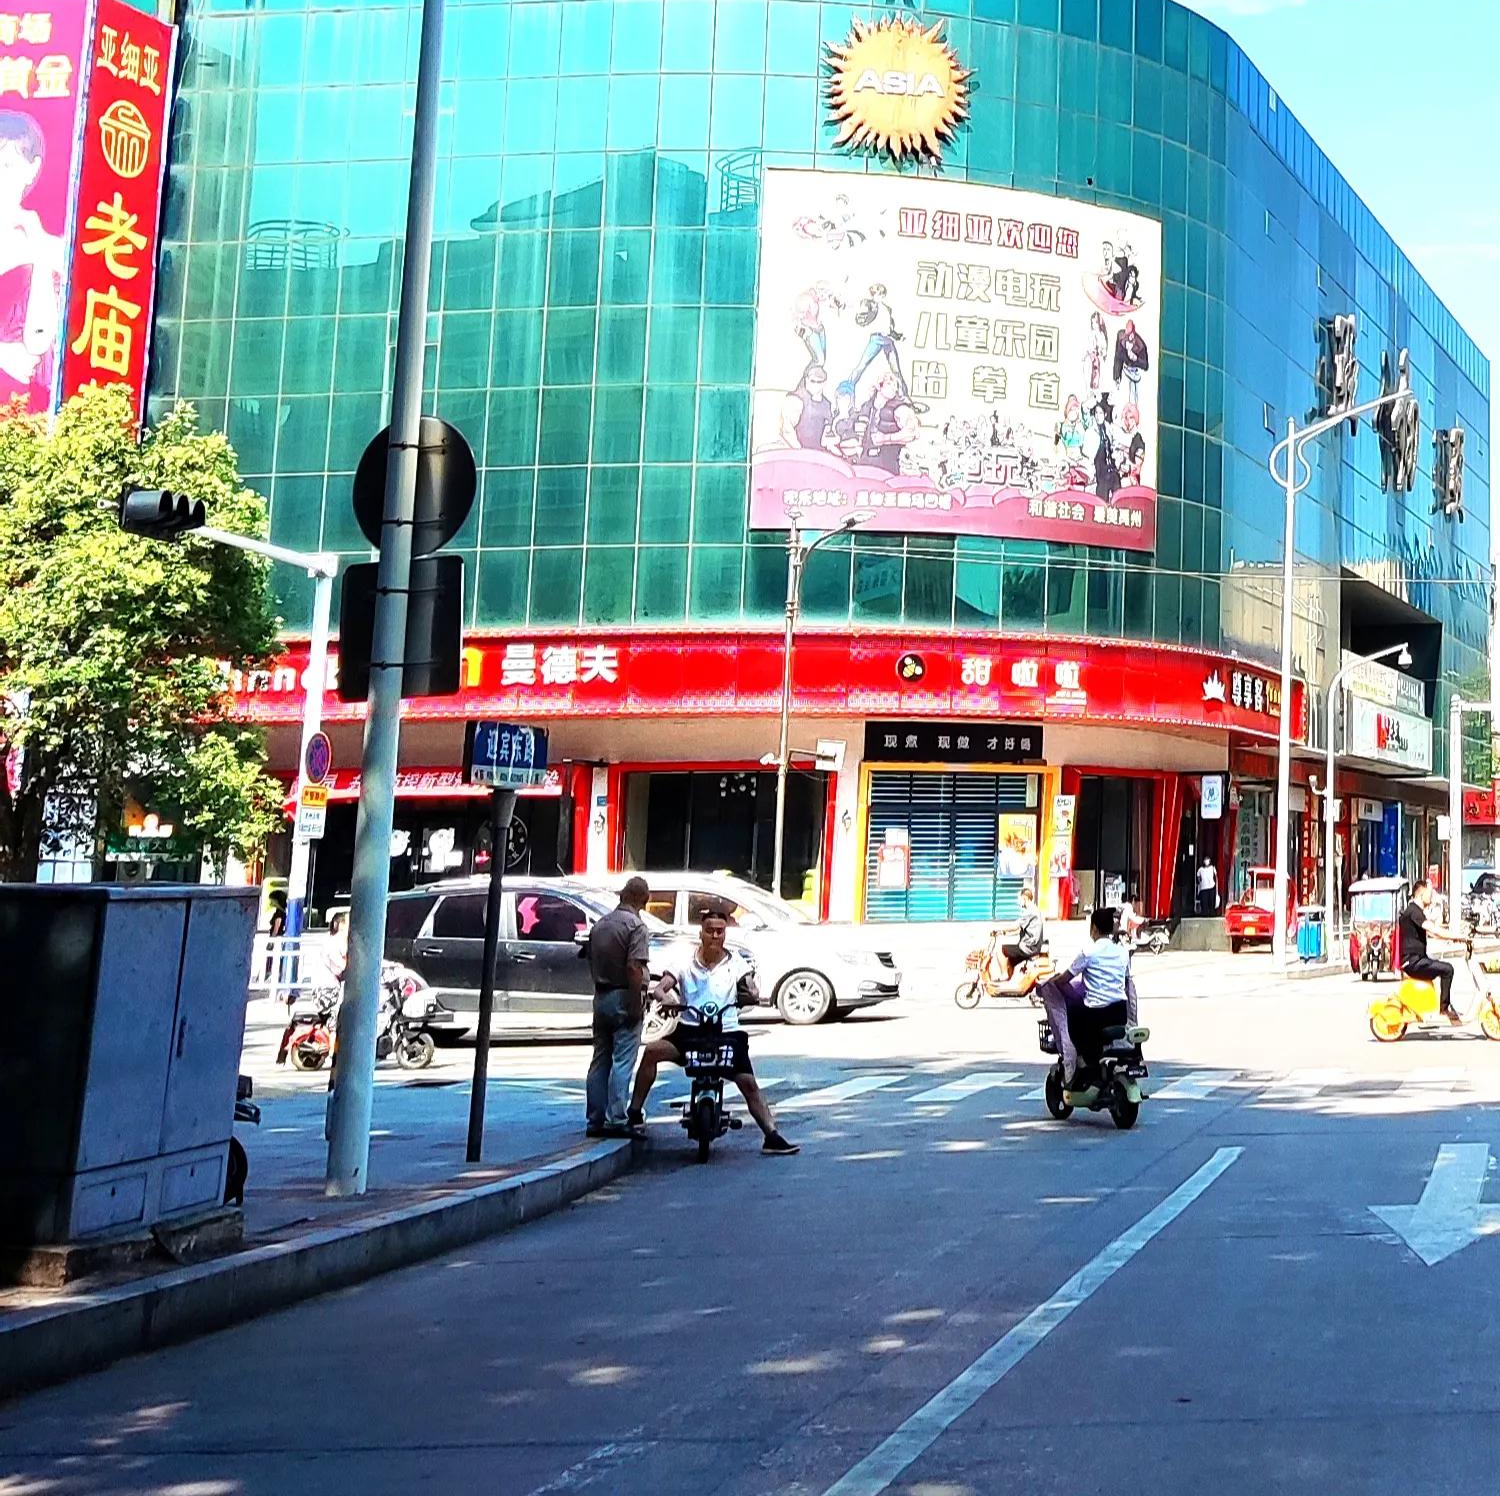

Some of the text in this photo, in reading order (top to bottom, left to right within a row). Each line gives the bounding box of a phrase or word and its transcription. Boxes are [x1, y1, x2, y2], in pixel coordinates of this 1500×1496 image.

[97, 24, 161, 96] 亚细亚
[854, 68, 945, 98] ASIA
[898, 207, 1080, 259] 亚细亚欢迎您
[71, 191, 148, 407] 老庙
[916, 260, 1061, 312] 动漫电玩
[914, 311, 1060, 363] 儿童乐园
[911, 359, 1061, 411] 跆拳道
[1028, 498, 1085, 522] 和谐社会
[500, 644, 619, 686] 曼德夫
[960, 657, 1081, 689] 甜啦啦
